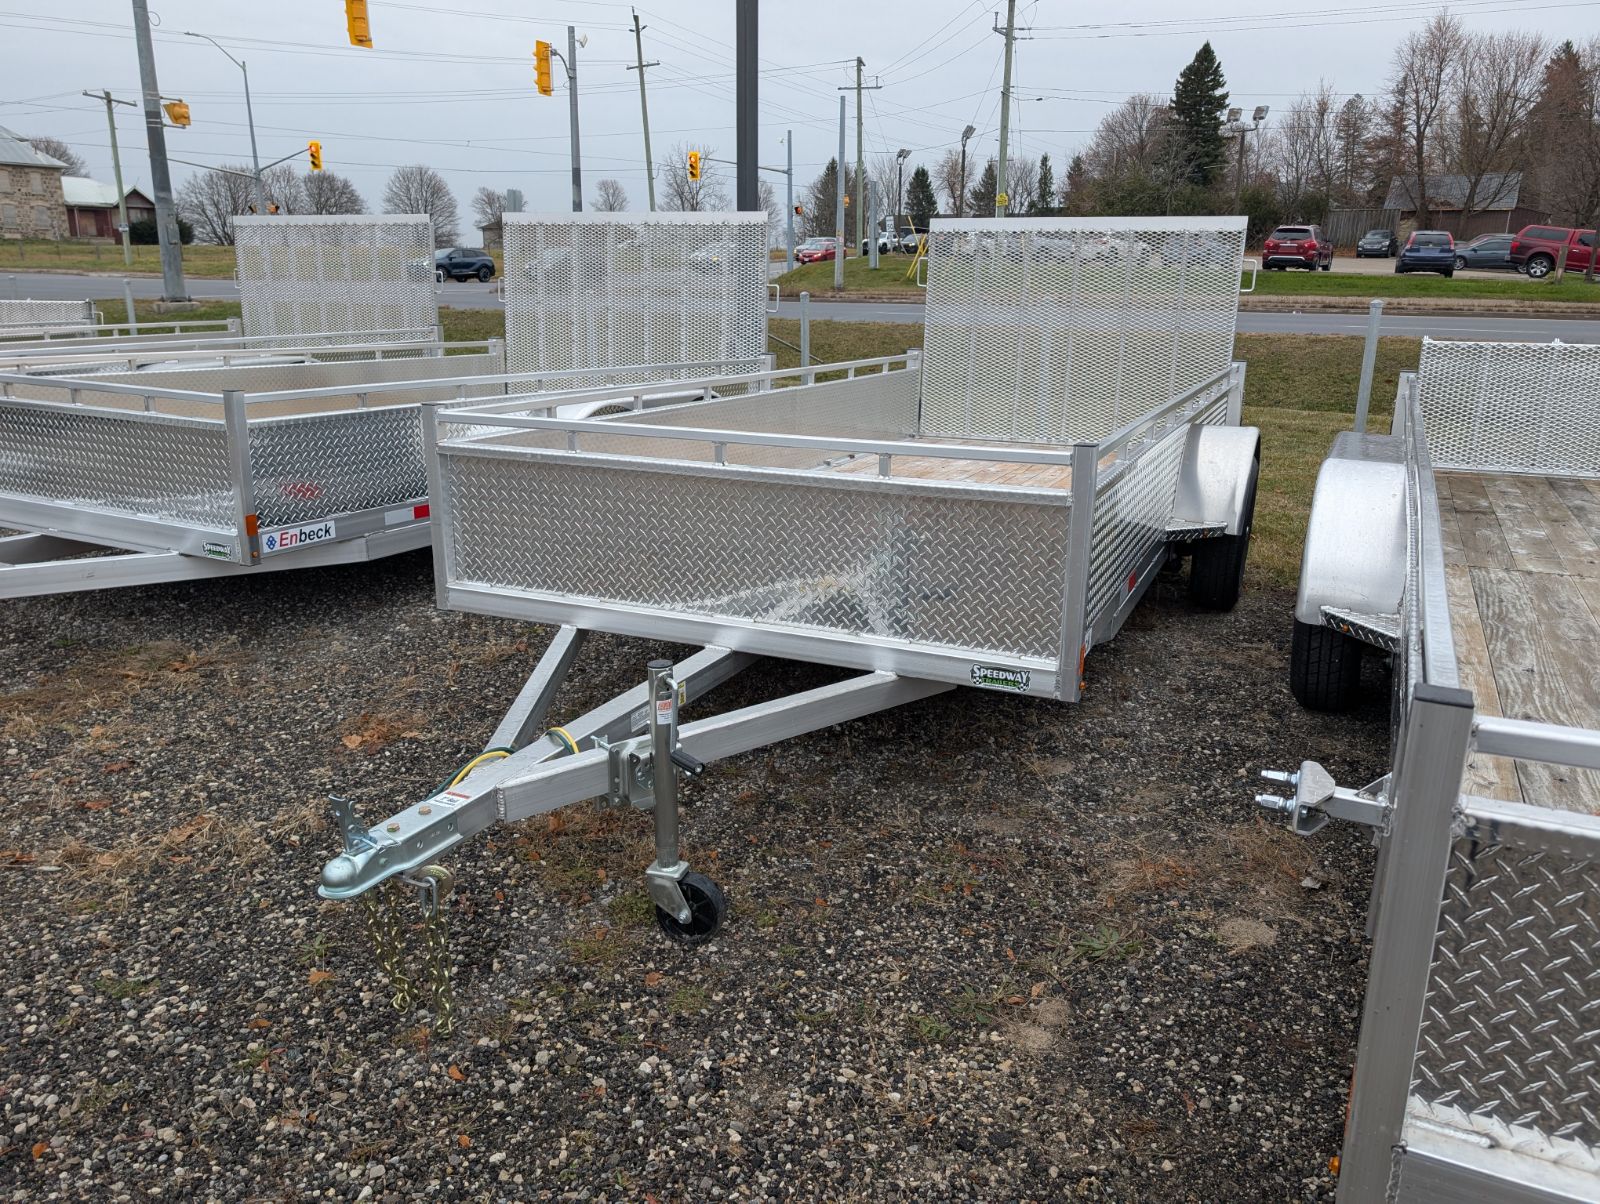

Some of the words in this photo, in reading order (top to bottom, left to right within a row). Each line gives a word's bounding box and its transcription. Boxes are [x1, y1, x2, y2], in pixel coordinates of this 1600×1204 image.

[280, 524, 331, 547] Enbeck
[973, 665, 1028, 684] SPEEDWAY
[982, 678, 1019, 687] TRAILERS
